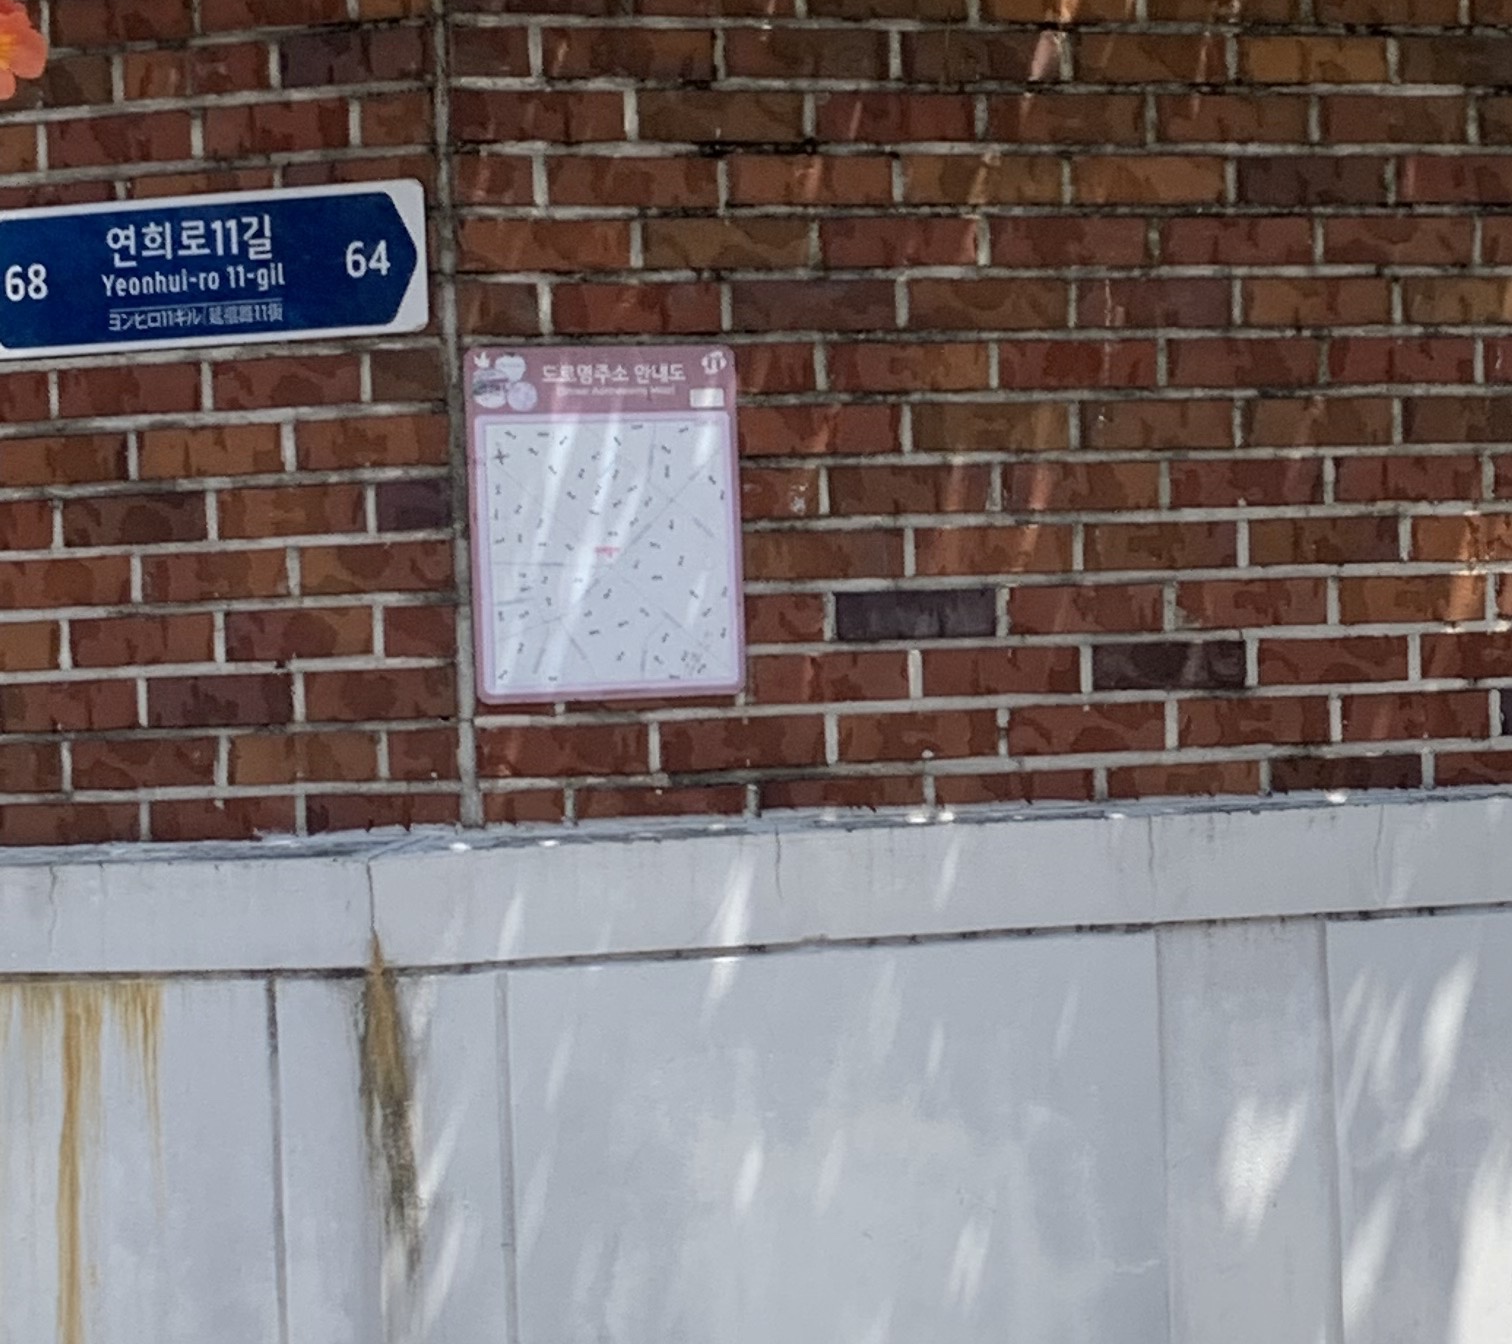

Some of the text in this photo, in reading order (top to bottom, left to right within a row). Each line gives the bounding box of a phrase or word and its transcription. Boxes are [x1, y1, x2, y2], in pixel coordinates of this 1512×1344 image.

[106, 213, 273, 268] 연희로11길
[345, 239, 391, 278] 64
[5, 262, 48, 302] 68
[101, 262, 286, 297] Yeonhui-ro 11-gil
